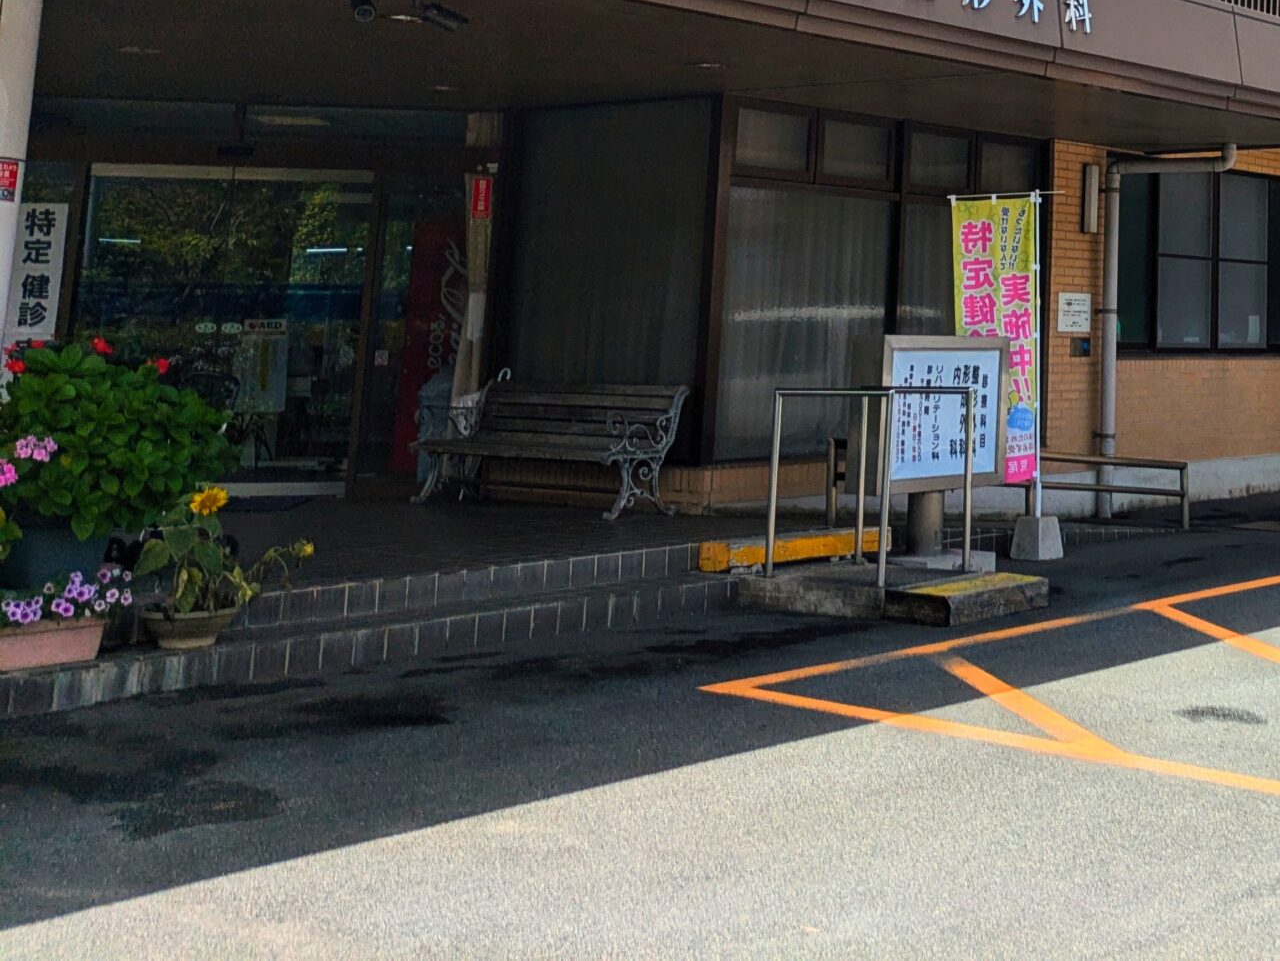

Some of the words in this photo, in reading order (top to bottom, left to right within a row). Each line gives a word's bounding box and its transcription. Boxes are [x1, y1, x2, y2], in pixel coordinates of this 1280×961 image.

[17, 208, 56, 328] 特定健診
[931, 364, 944, 461] リハリテーション科
